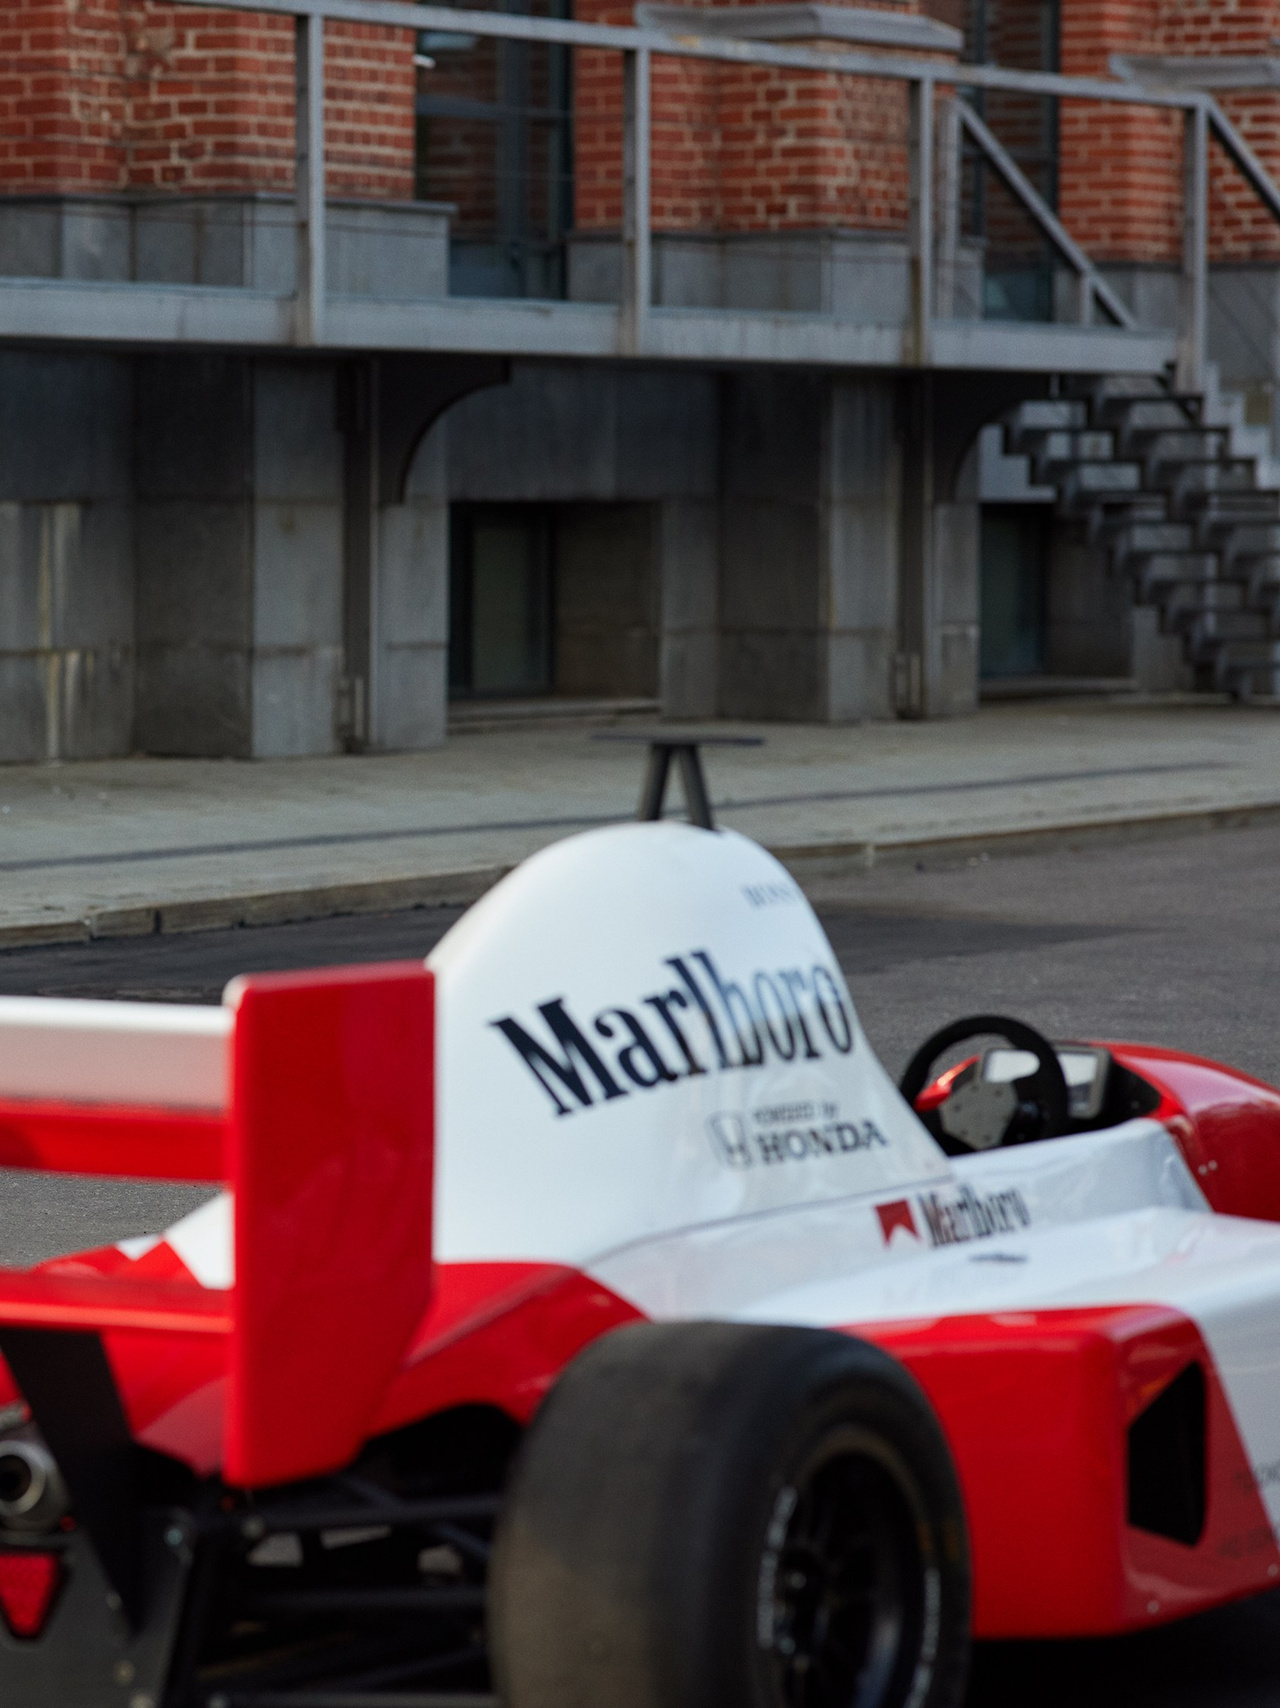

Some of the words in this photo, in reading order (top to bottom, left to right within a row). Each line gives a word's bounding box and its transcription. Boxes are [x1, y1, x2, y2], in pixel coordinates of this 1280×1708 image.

[488, 949, 854, 1118] Marlboro
[754, 1119, 888, 1165] HONDA
[917, 1184, 1031, 1247] Marlboro
